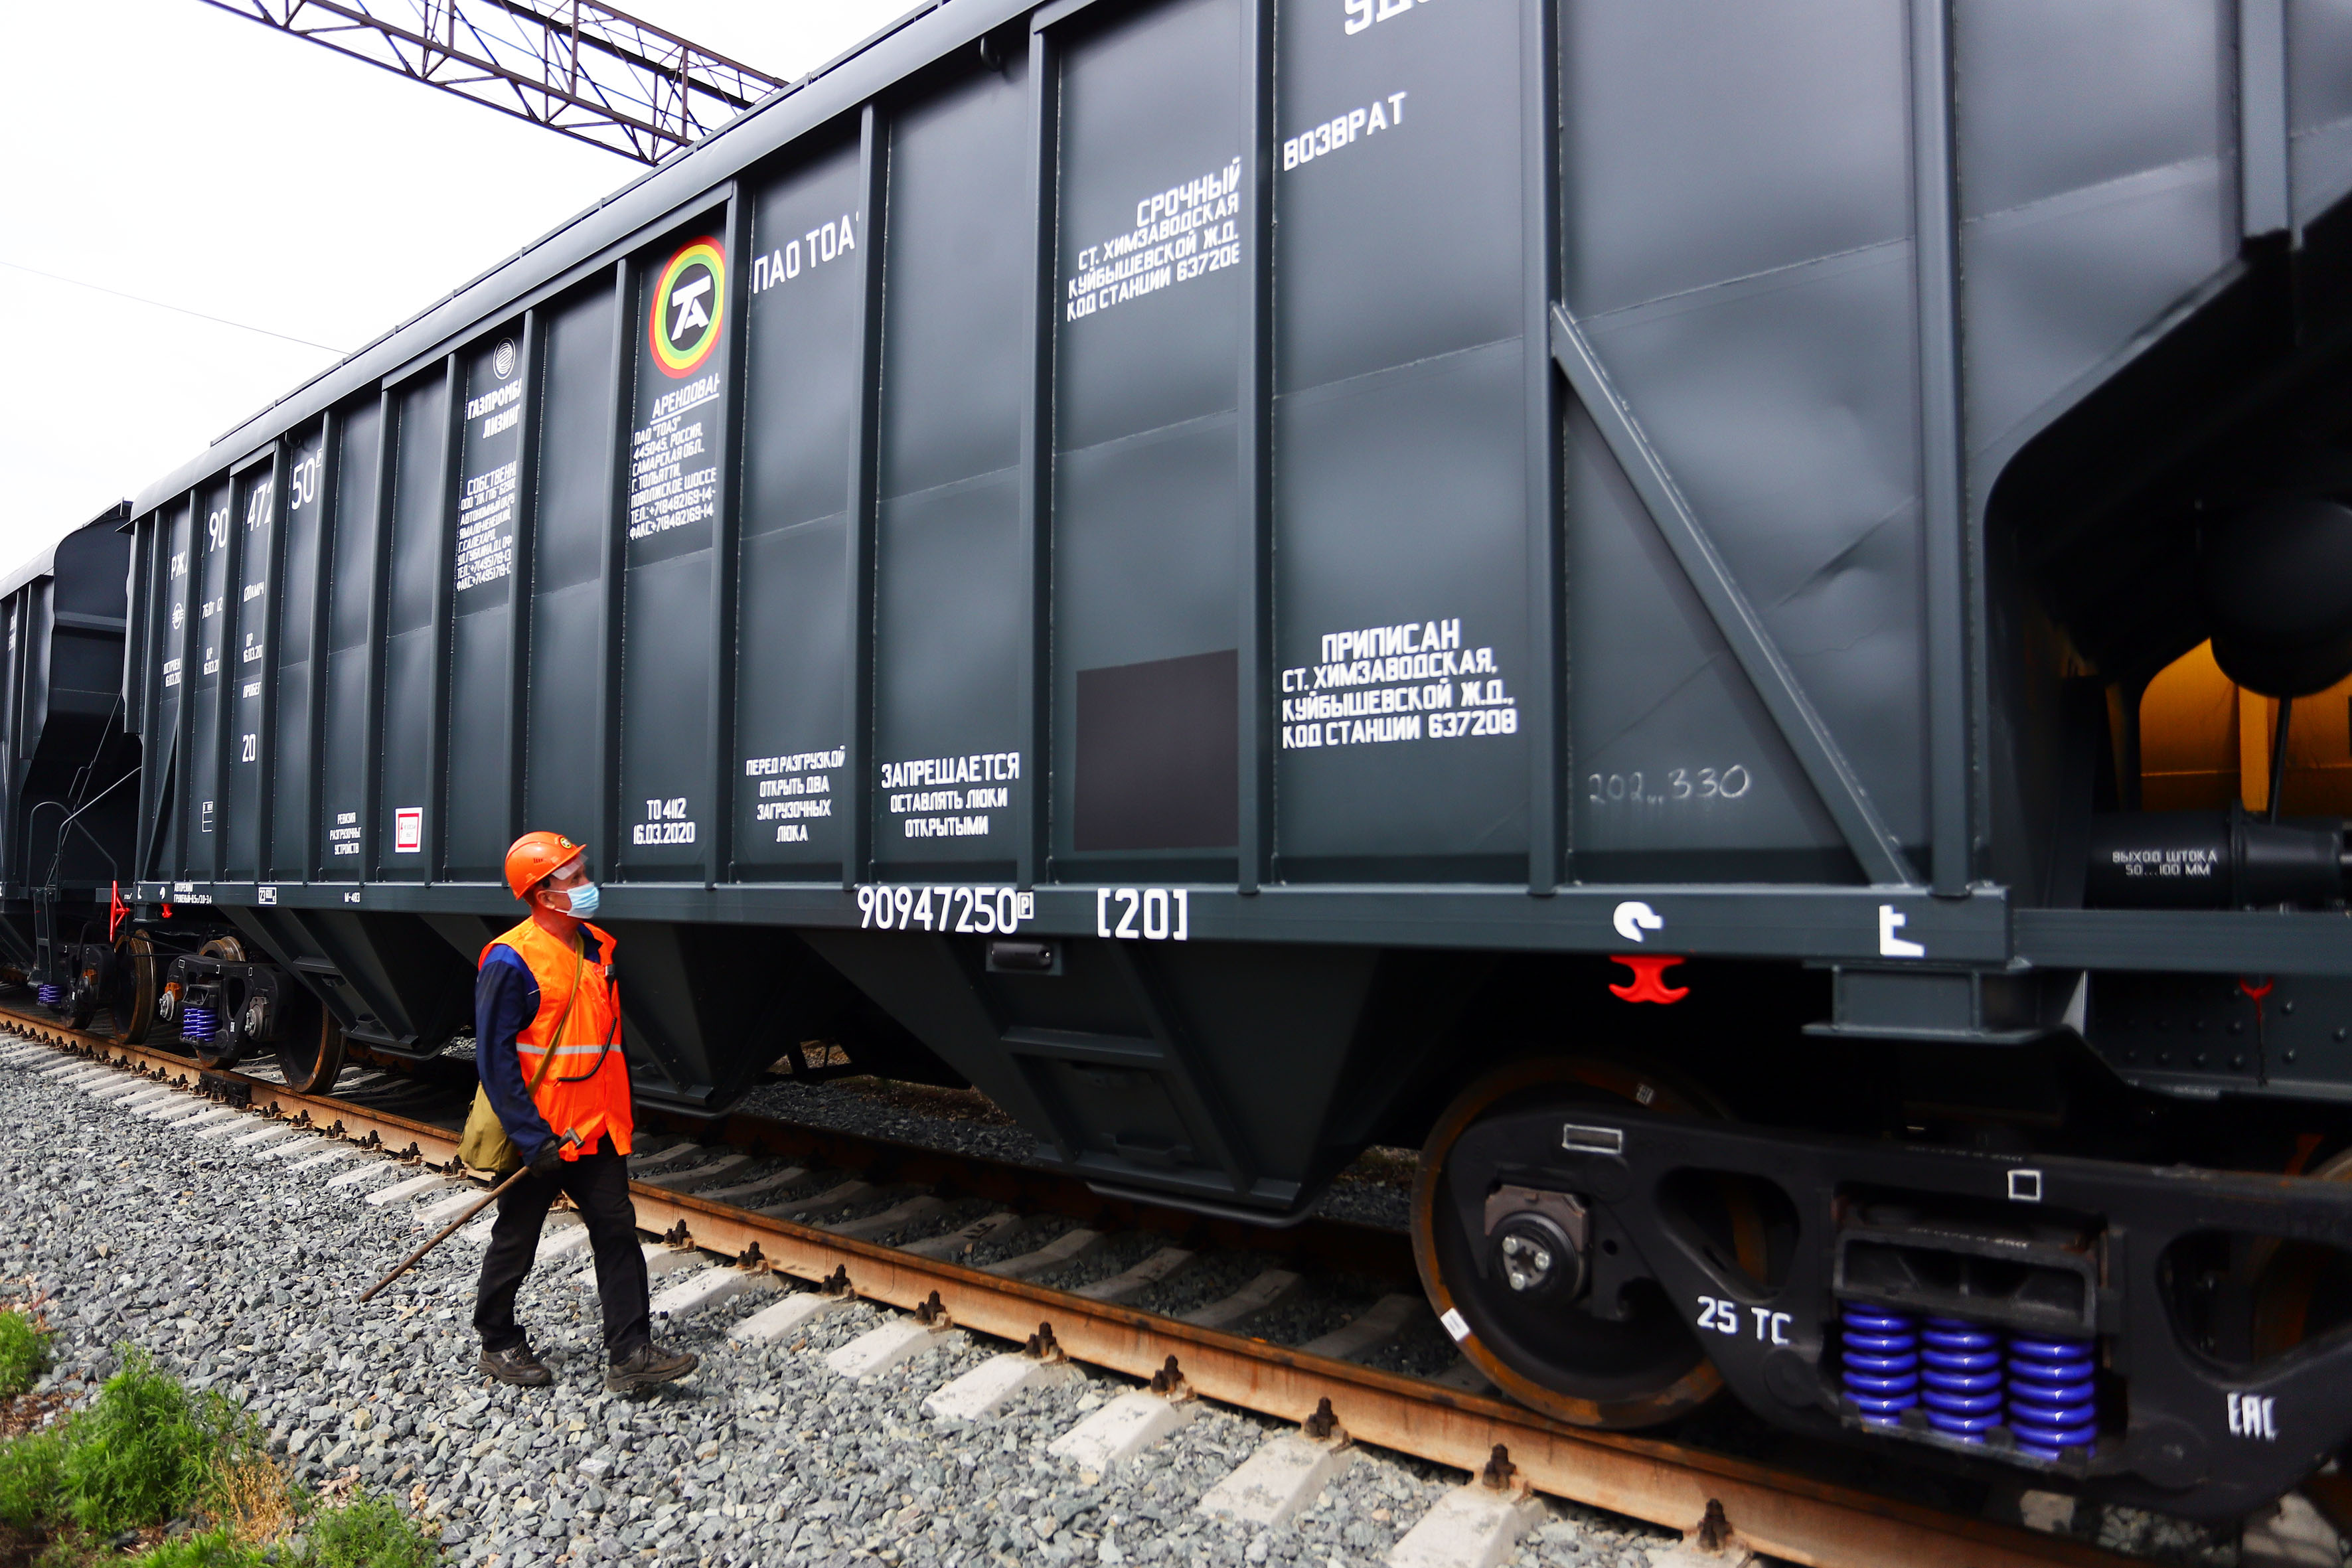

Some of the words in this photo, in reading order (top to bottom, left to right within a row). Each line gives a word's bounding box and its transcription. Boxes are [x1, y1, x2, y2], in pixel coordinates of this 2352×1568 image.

[1136, 157, 1241, 227] СРОЧНЫЙ
[1284, 91, 1406, 171] ВОЗВРАТ
[1078, 246, 1100, 271] СТ.
[1103, 193, 1239, 262] ХИМЗАВОДСКАЯ
[753, 240, 801, 294] ПАО
[805, 210, 859, 268] ТОА
[1068, 230, 1198, 299] КУЙБЫШЕВСКОЙ
[1203, 220, 1239, 250] Ж.Д.
[1067, 293, 1097, 322] КОД
[1099, 266, 1171, 309] СТАНЦИИ
[483, 404, 520, 439] ЛИЗИНГ
[634, 428, 652, 446] ПАО
[632, 445, 682, 477] САМАРСКАЯ
[291, 457, 315, 510] 50
[631, 478, 683, 509] ПОВОЛЖСКОЕ
[684, 467, 717, 492] ШОССЕ
[209, 507, 229, 552] 90
[171, 550, 187, 580] РЖ
[1322, 618, 1460, 663] ПРИПИСАН
[1282, 667, 1310, 693] СТ.
[1313, 647, 1498, 690] ХИМЗАВОДСКАЯ,
[1282, 677, 1452, 722] КУЙБЫШЕВСКОЙ
[1282, 723, 1322, 749] КОД
[1326, 714, 1421, 745] СТАНЦИИ
[1428, 708, 1518, 738] 637208
[242, 734, 256, 762] 20
[745, 757, 779, 776] ПЕРЕД
[779, 745, 846, 773] РАЗГРУЗКОЙ
[759, 777, 805, 797] ОТКРЫТЬ
[805, 775, 830, 794] ДВА
[890, 790, 963, 813] ОСТАВЛЯТЬ
[965, 787, 1008, 809] ЛЮКИ
[337, 812, 356, 825] РЕВИЗИЯ
[646, 799, 662, 821] ТО
[757, 799, 832, 821] ЗАГРУЗОЧНЫХ
[905, 815, 988, 838] ОТКРЫТЫМИ
[633, 822, 696, 844] 16.03.2020
[776, 824, 809, 842] ЛЮКА
[2112, 850, 2161, 863] ВЫХОД
[2165, 849, 2218, 863] ШТОКА
[2185, 864, 2211, 876] ММ
[857, 886, 1018, 934] 90947250
[1097, 888, 1188, 941] [20]
[1697, 1295, 1738, 1334] 25
